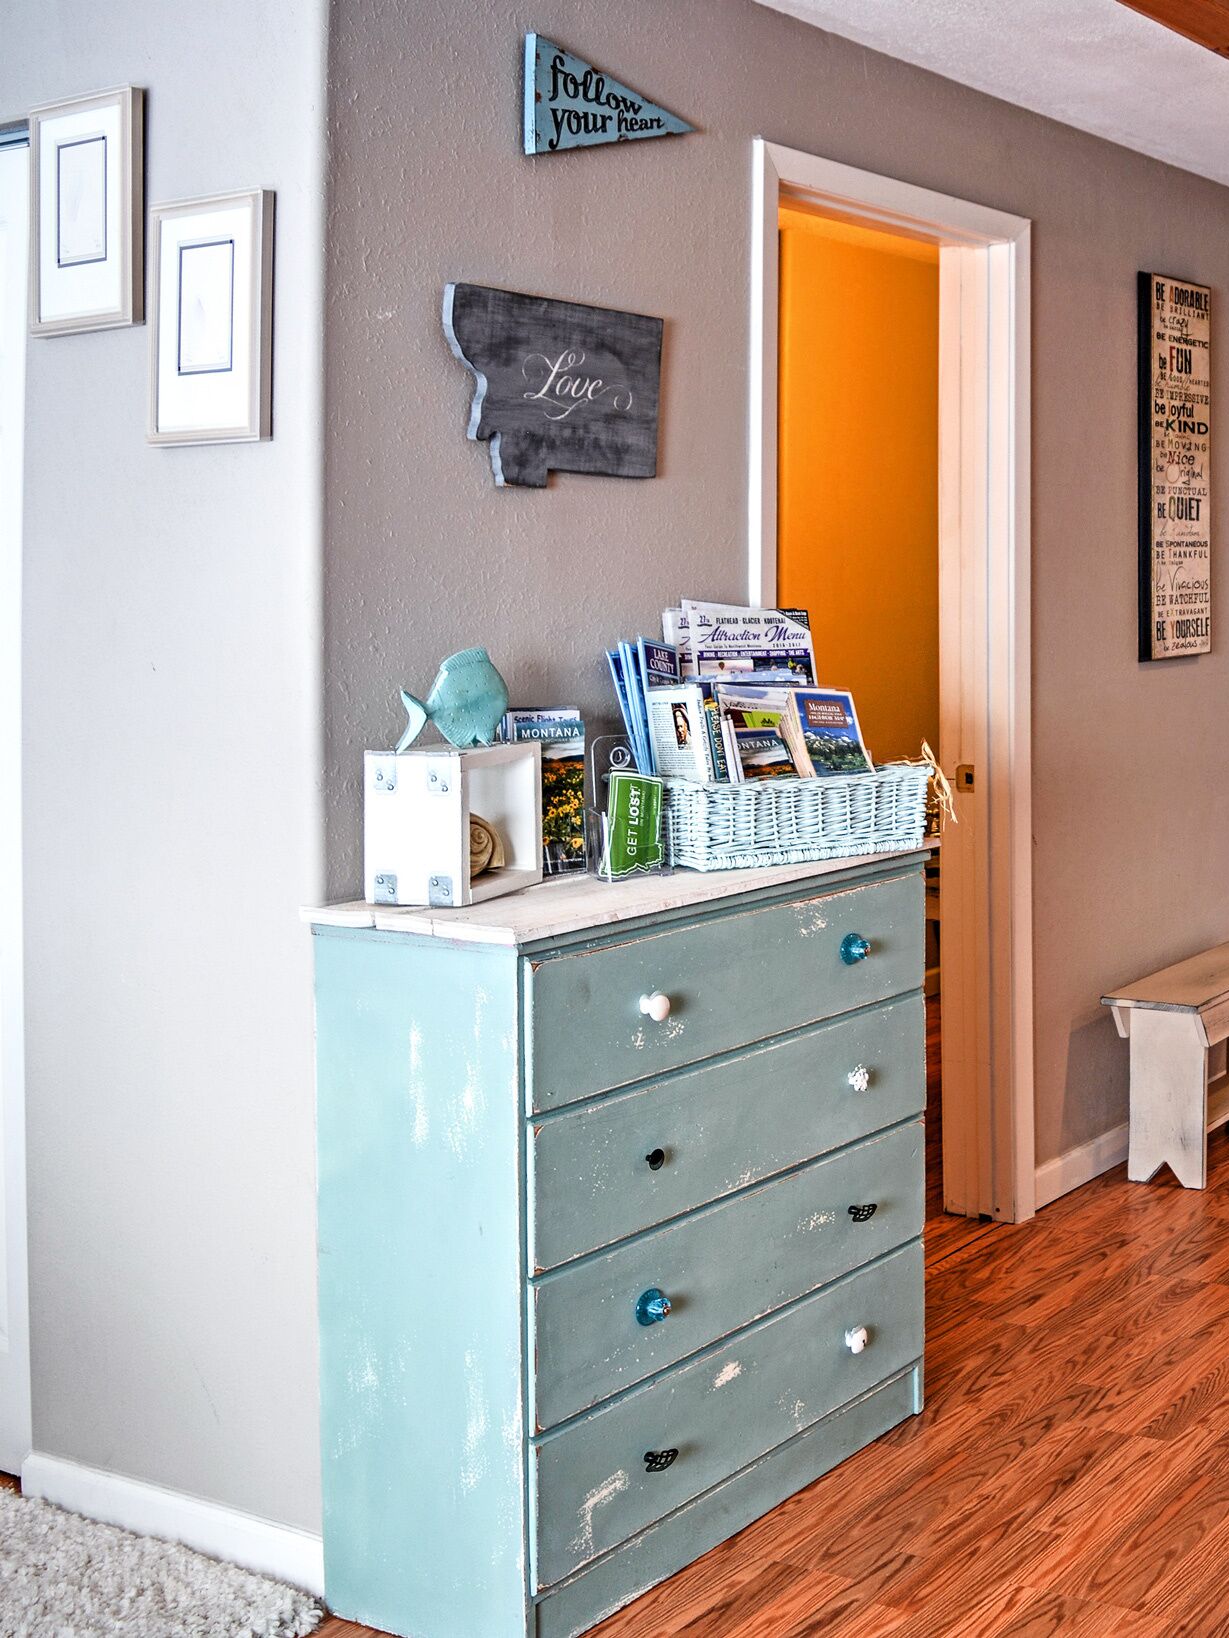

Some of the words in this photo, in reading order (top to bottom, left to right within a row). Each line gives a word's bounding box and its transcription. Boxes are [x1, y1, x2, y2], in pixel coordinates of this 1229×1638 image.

[549, 55, 643, 115] follow
[548, 105, 613, 150] your
[616, 110, 665, 133] heart
[1156, 282, 1165, 301] BE
[1169, 286, 1208, 312] ADORABLE
[1170, 305, 1209, 320] BRILLIANT
[1156, 332, 1166, 341] BE
[1169, 335, 1209, 349] ENERGETIC
[1169, 346, 1192, 375] FUN
[522, 348, 633, 420] Love
[1155, 399, 1166, 415] be
[1166, 419, 1208, 435] KIND
[1156, 440, 1165, 449] BE
[1168, 439, 1207, 453] MOVING
[1167, 451, 1195, 465] Nice
[1168, 486, 1207, 496] PUNCTUAL
[1158, 502, 1166, 518] BE
[1169, 496, 1202, 521] QUIET
[1166, 540, 1208, 548] SPONTANEOUS
[1156, 551, 1165, 559] BE
[1169, 549, 1208, 559] THANKFUL
[1169, 592, 1209, 605] WATCHFUL
[697, 625, 761, 643] Attraction
[764, 625, 805, 643] Menu
[1156, 621, 1166, 641] BE
[1170, 617, 1209, 640] YOURSELF
[653, 648, 669, 662] LAKE
[649, 658, 674, 673] COUNTY
[808, 703, 840, 712] Montana
[514, 715, 535, 723] Scenic
[521, 727, 580, 738] MONTANA
[736, 739, 779, 750] ONTANA
[626, 829, 638, 856] GET
